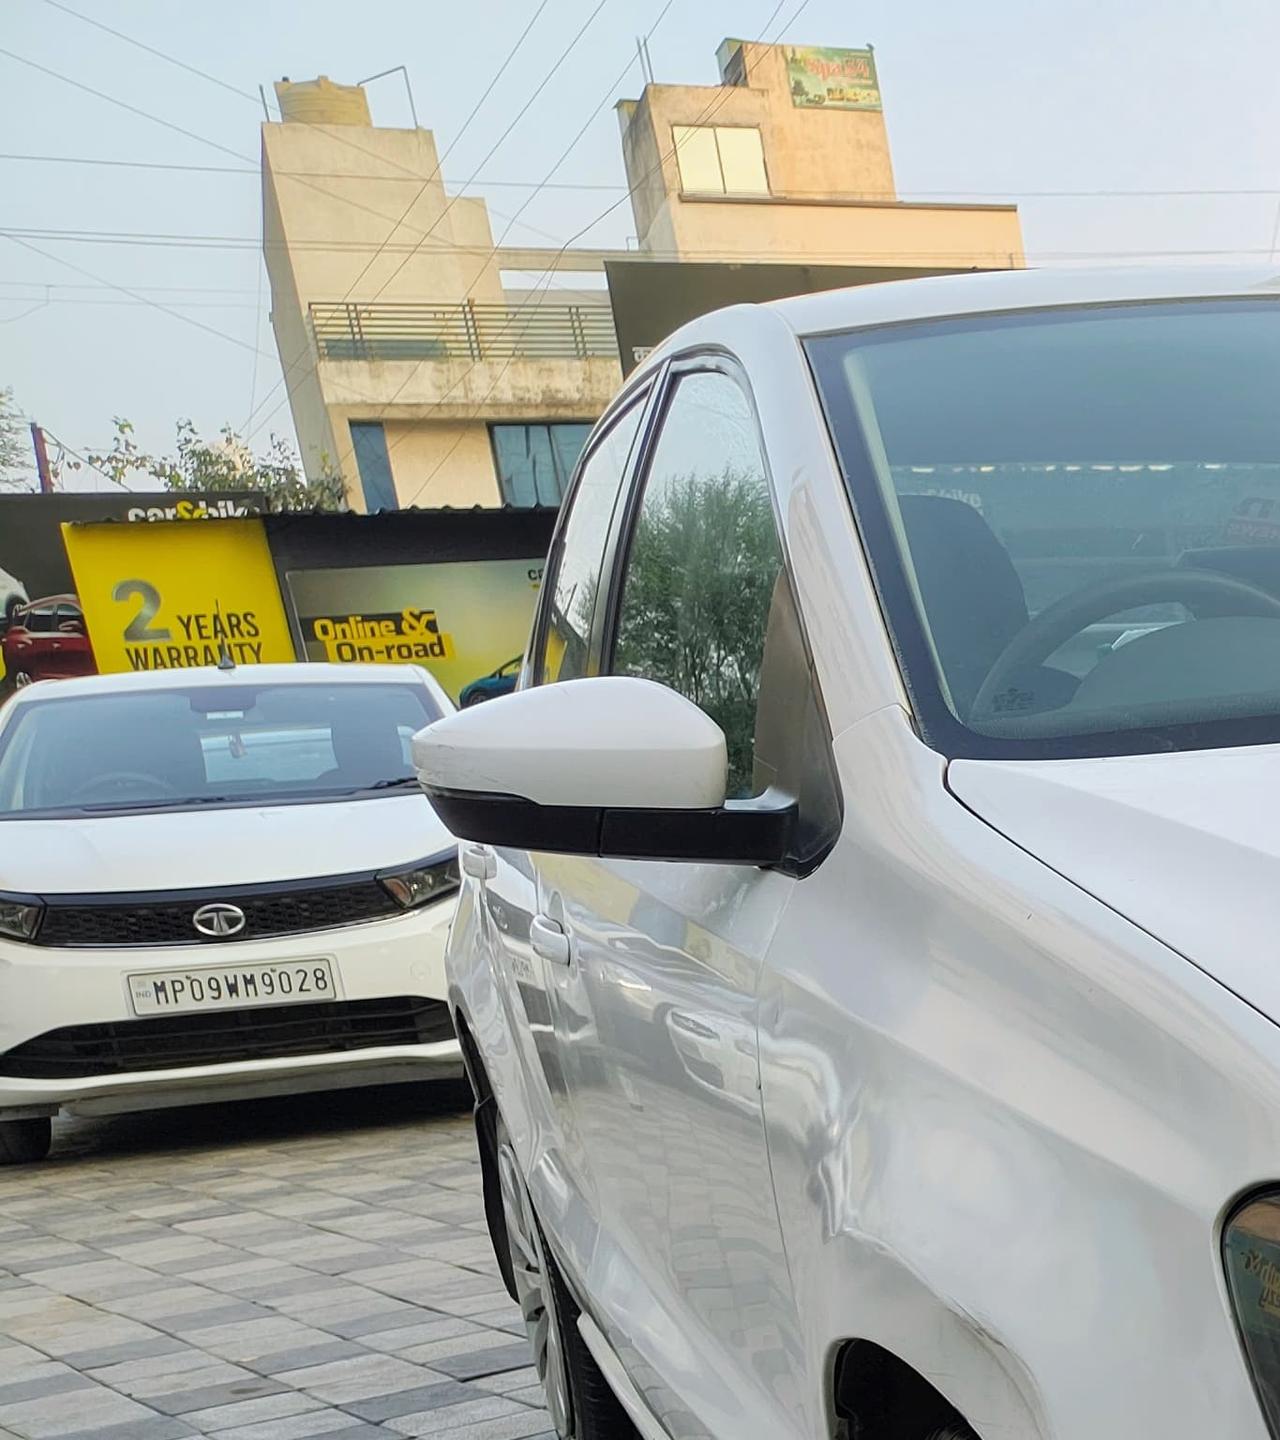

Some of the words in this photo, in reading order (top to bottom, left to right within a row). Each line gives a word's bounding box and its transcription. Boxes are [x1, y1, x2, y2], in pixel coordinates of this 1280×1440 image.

[112, 578, 172, 642] 2
[177, 611, 260, 642] YEARS
[313, 614, 396, 642] Online
[401, 607, 436, 638] &
[335, 634, 446, 663] On-road
[152, 967, 328, 1006] MP09WM9028
